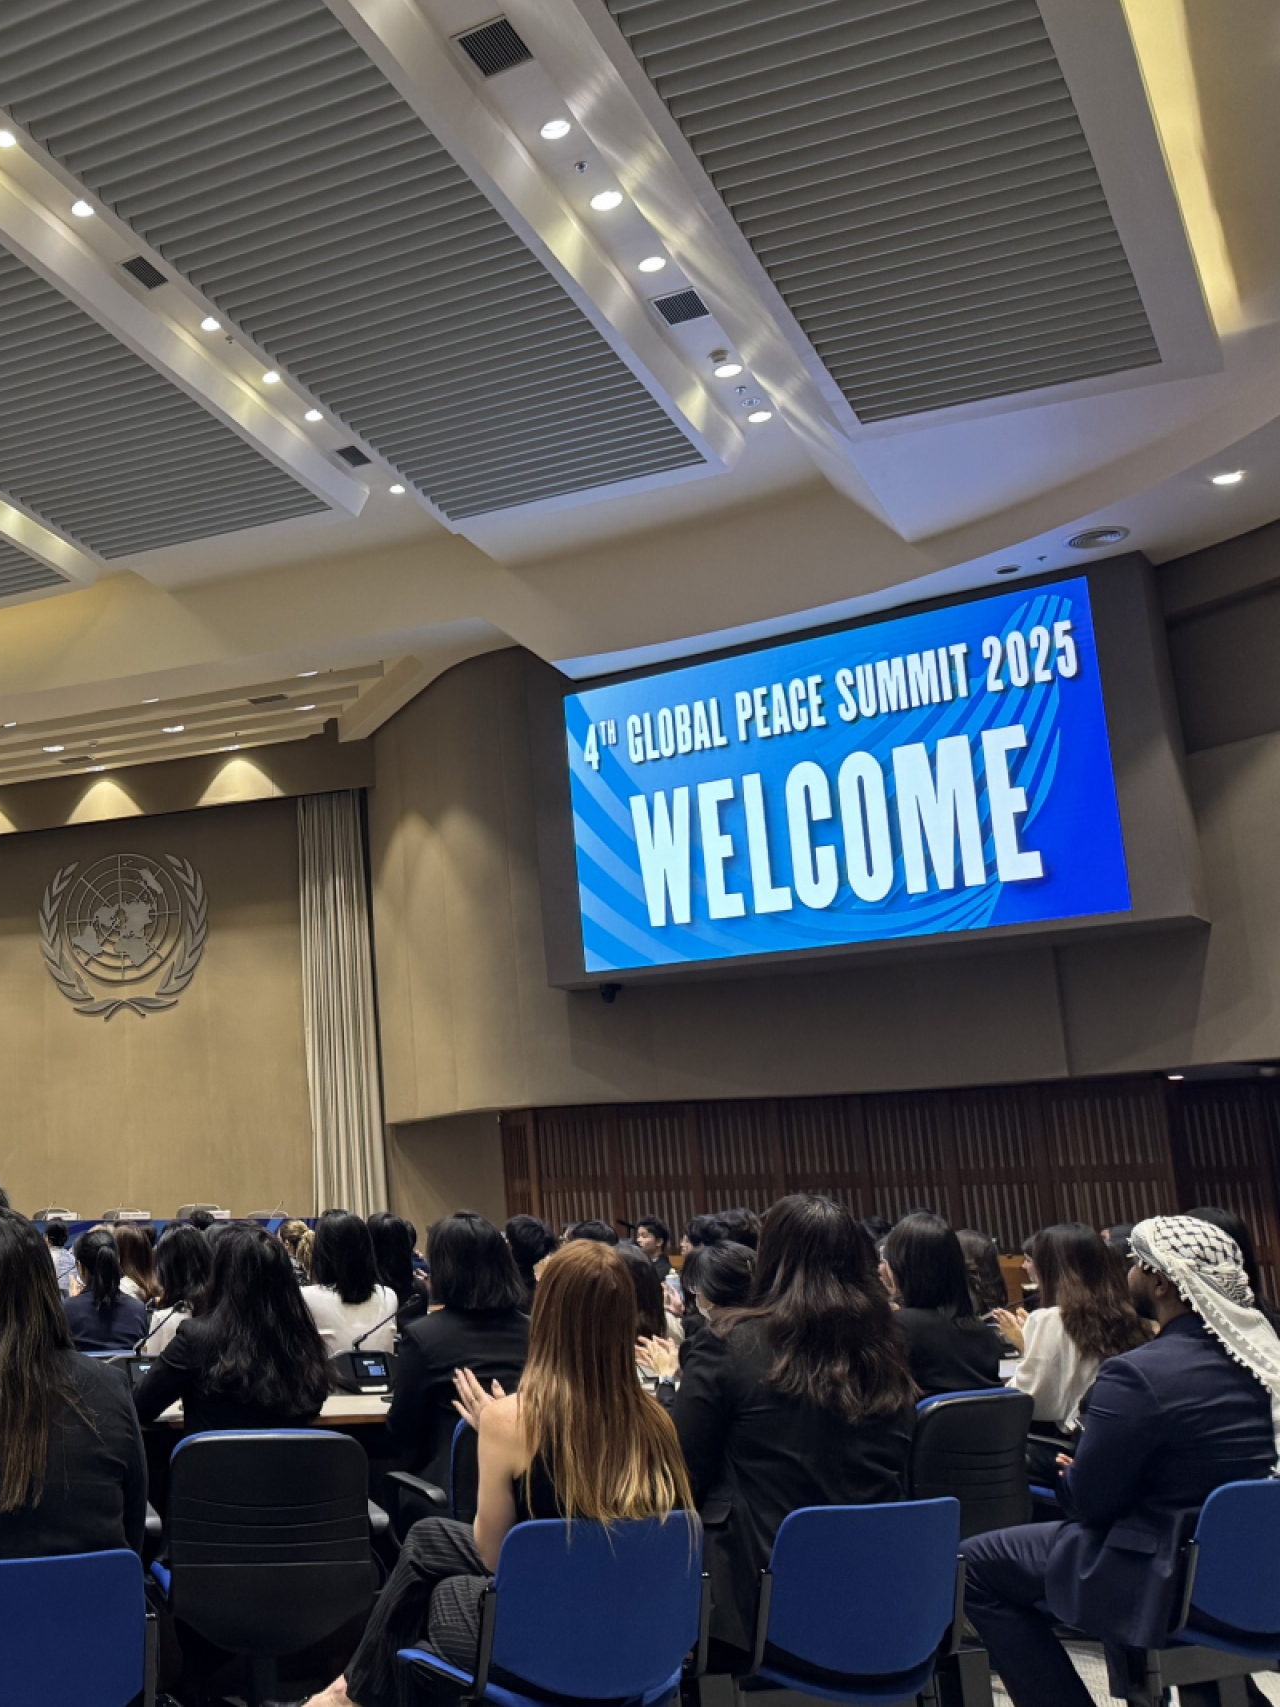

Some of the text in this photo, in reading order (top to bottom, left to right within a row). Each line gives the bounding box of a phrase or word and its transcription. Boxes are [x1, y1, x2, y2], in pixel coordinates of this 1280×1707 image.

[583, 619, 1079, 771] 4TH GLOBAL PEACE SUMMIT 2025
[629, 724, 1044, 928] WELCOME
